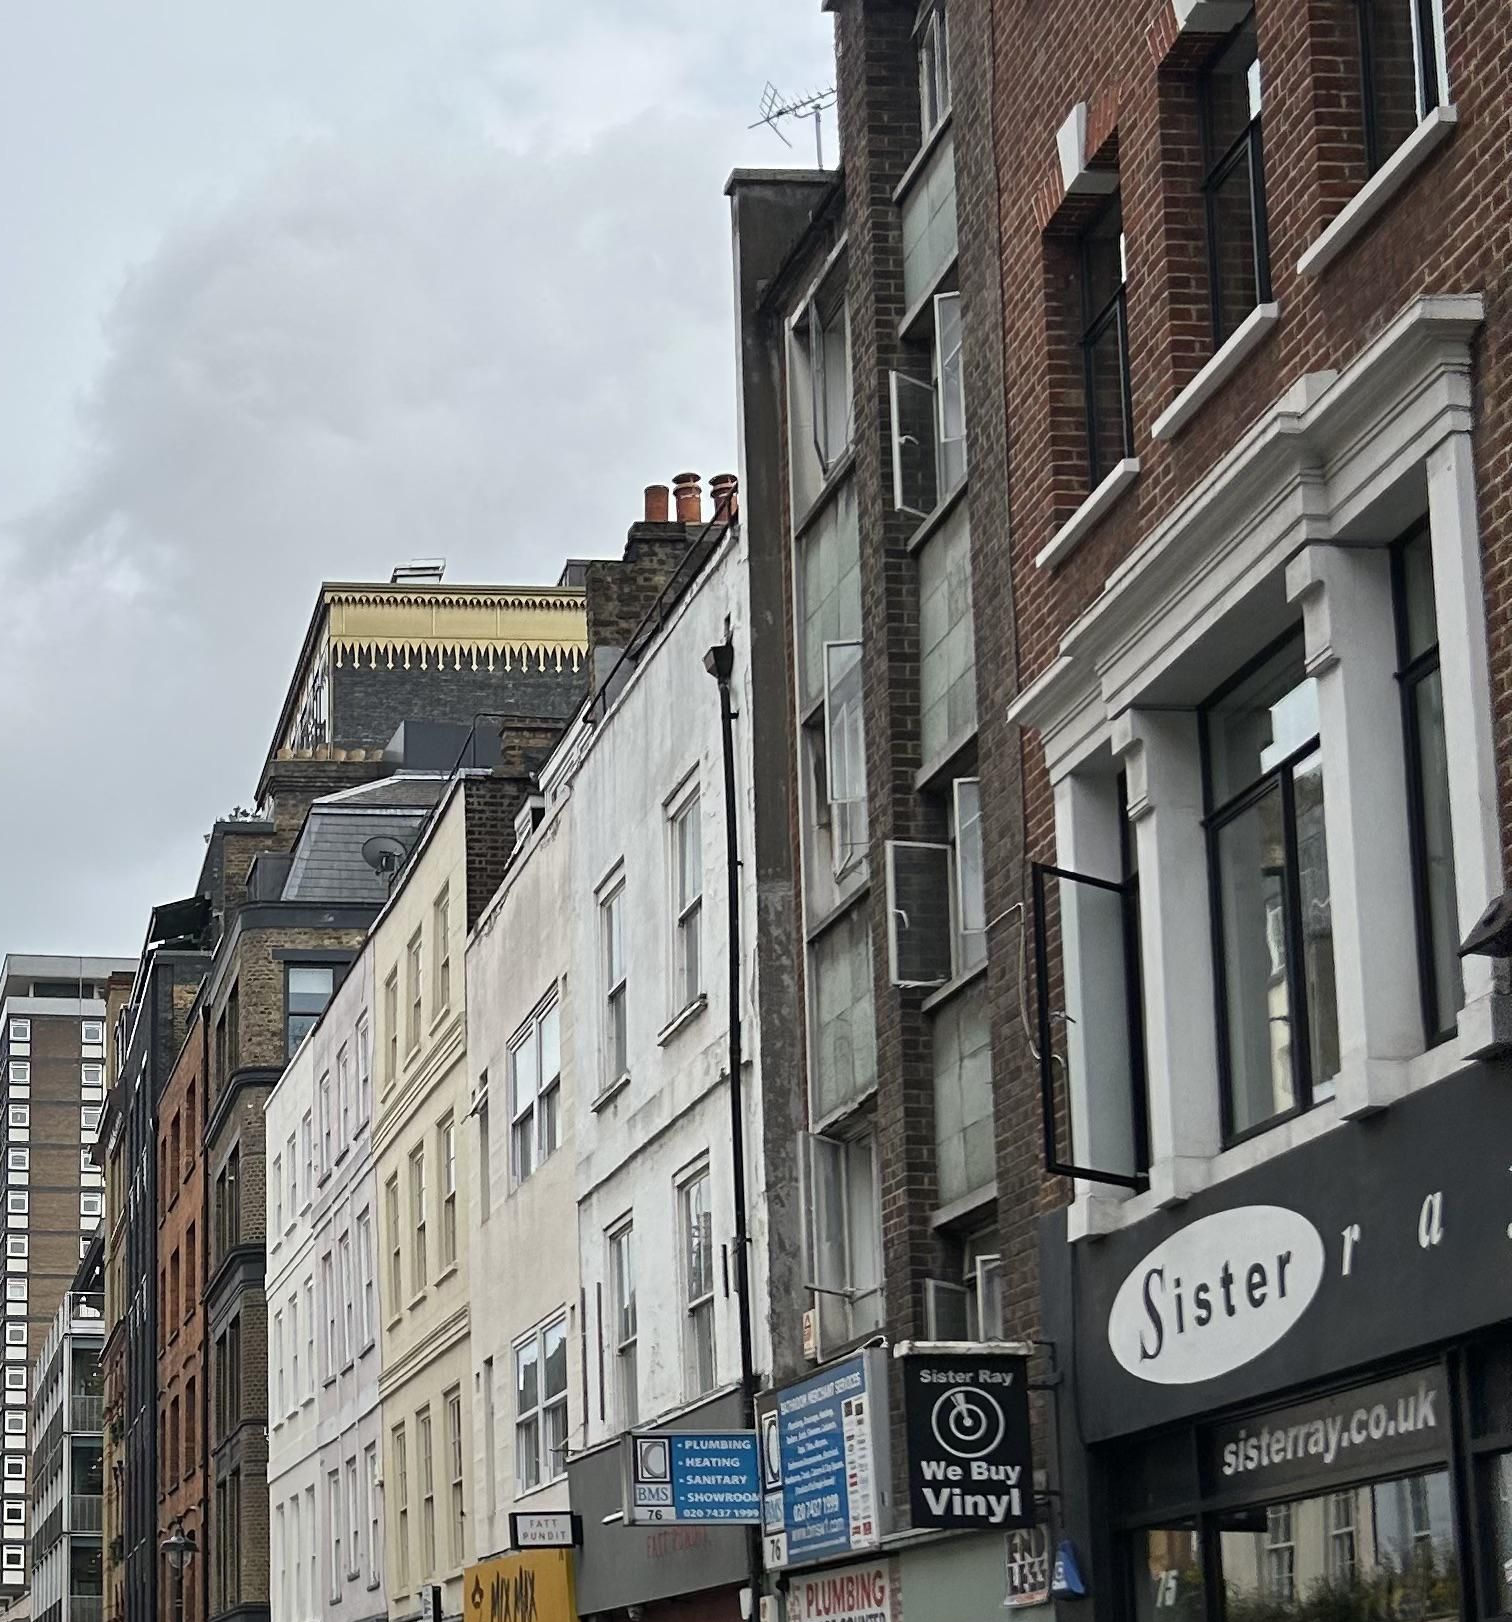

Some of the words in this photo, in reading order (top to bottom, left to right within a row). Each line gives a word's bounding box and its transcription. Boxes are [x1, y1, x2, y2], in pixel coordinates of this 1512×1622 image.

[1139, 1249, 1292, 1363] Sister
[920, 1369, 974, 1383] Sister
[978, 1369, 1014, 1387] Ray
[1222, 1380, 1439, 1477] sisterray.co.uk
[684, 1440, 751, 1450] PLUMBING
[686, 1458, 741, 1467] HEATING
[686, 1475, 748, 1485] SANITARY
[920, 1460, 964, 1481] We
[970, 1461, 1022, 1486] Buy
[638, 1487, 669, 1502] BMS
[682, 1508, 704, 1518] 020
[705, 1508, 731, 1518] 7437
[733, 1508, 760, 1518] 1999
[922, 1487, 1023, 1524] Vinyl
[647, 1509, 664, 1520] 76
[529, 1519, 559, 1529] FATT
[521, 1531, 568, 1541] PUNDIT
[770, 1538, 782, 1562] 76
[805, 1569, 885, 1618] PLUMBING
